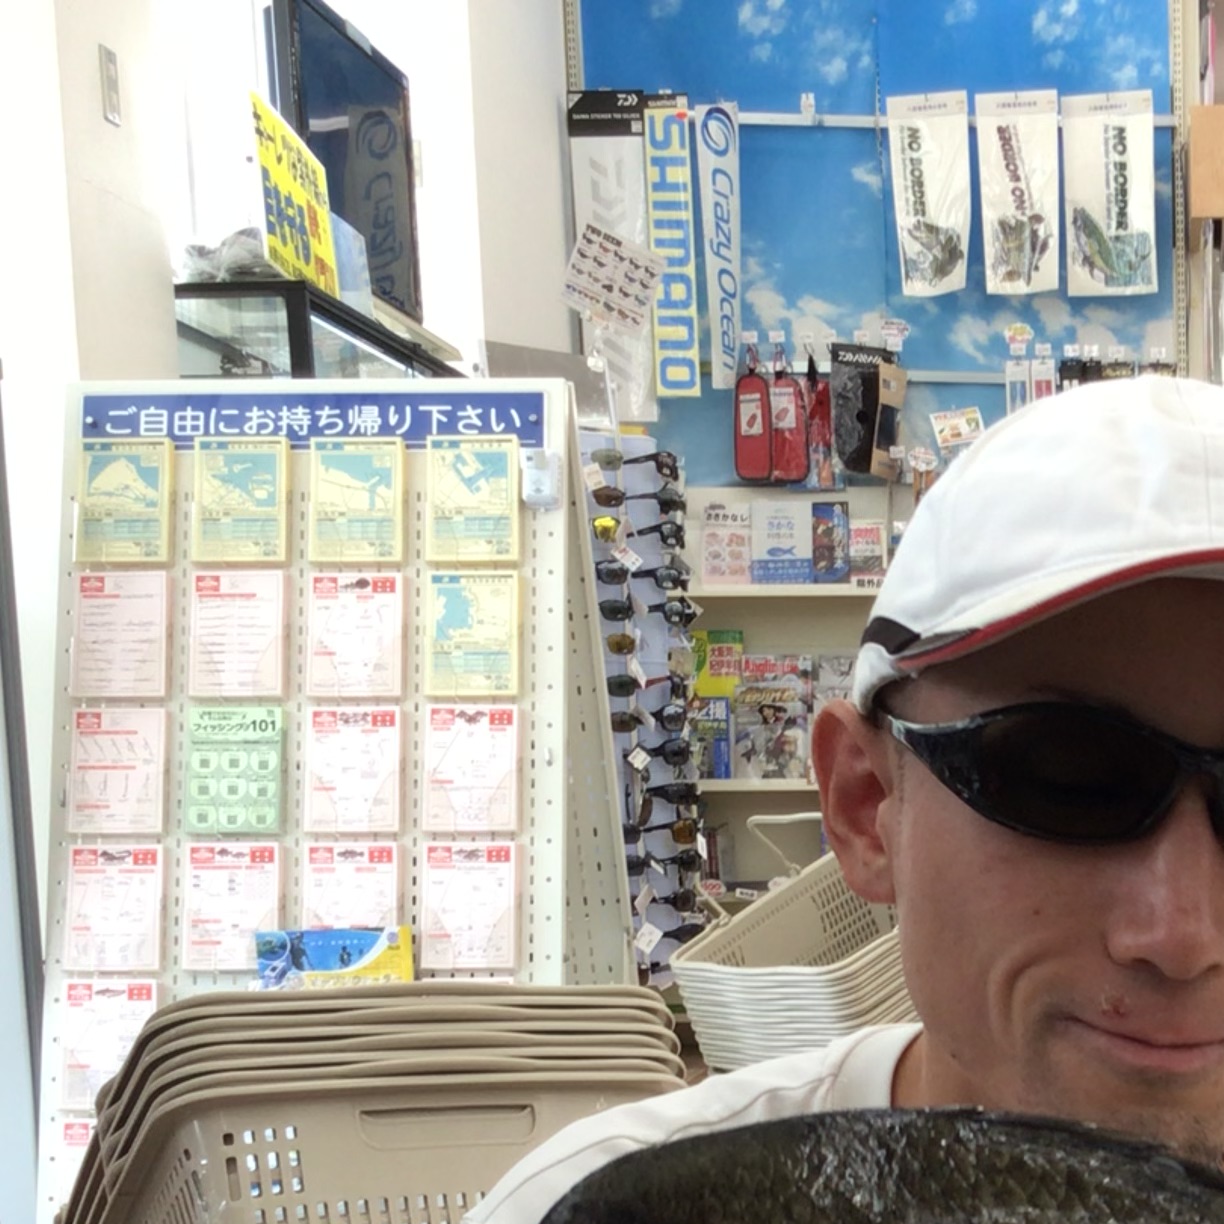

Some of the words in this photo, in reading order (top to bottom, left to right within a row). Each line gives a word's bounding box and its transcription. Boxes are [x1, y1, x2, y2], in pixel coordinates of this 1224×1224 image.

[1112, 126, 1127, 157] NO
[710, 167, 733, 264] Crazy
[1113, 161, 1129, 232] BORDER
[717, 268, 738, 371] Ocean
[105, 404, 522, 437] ご自由にお持ち帰り下さい
